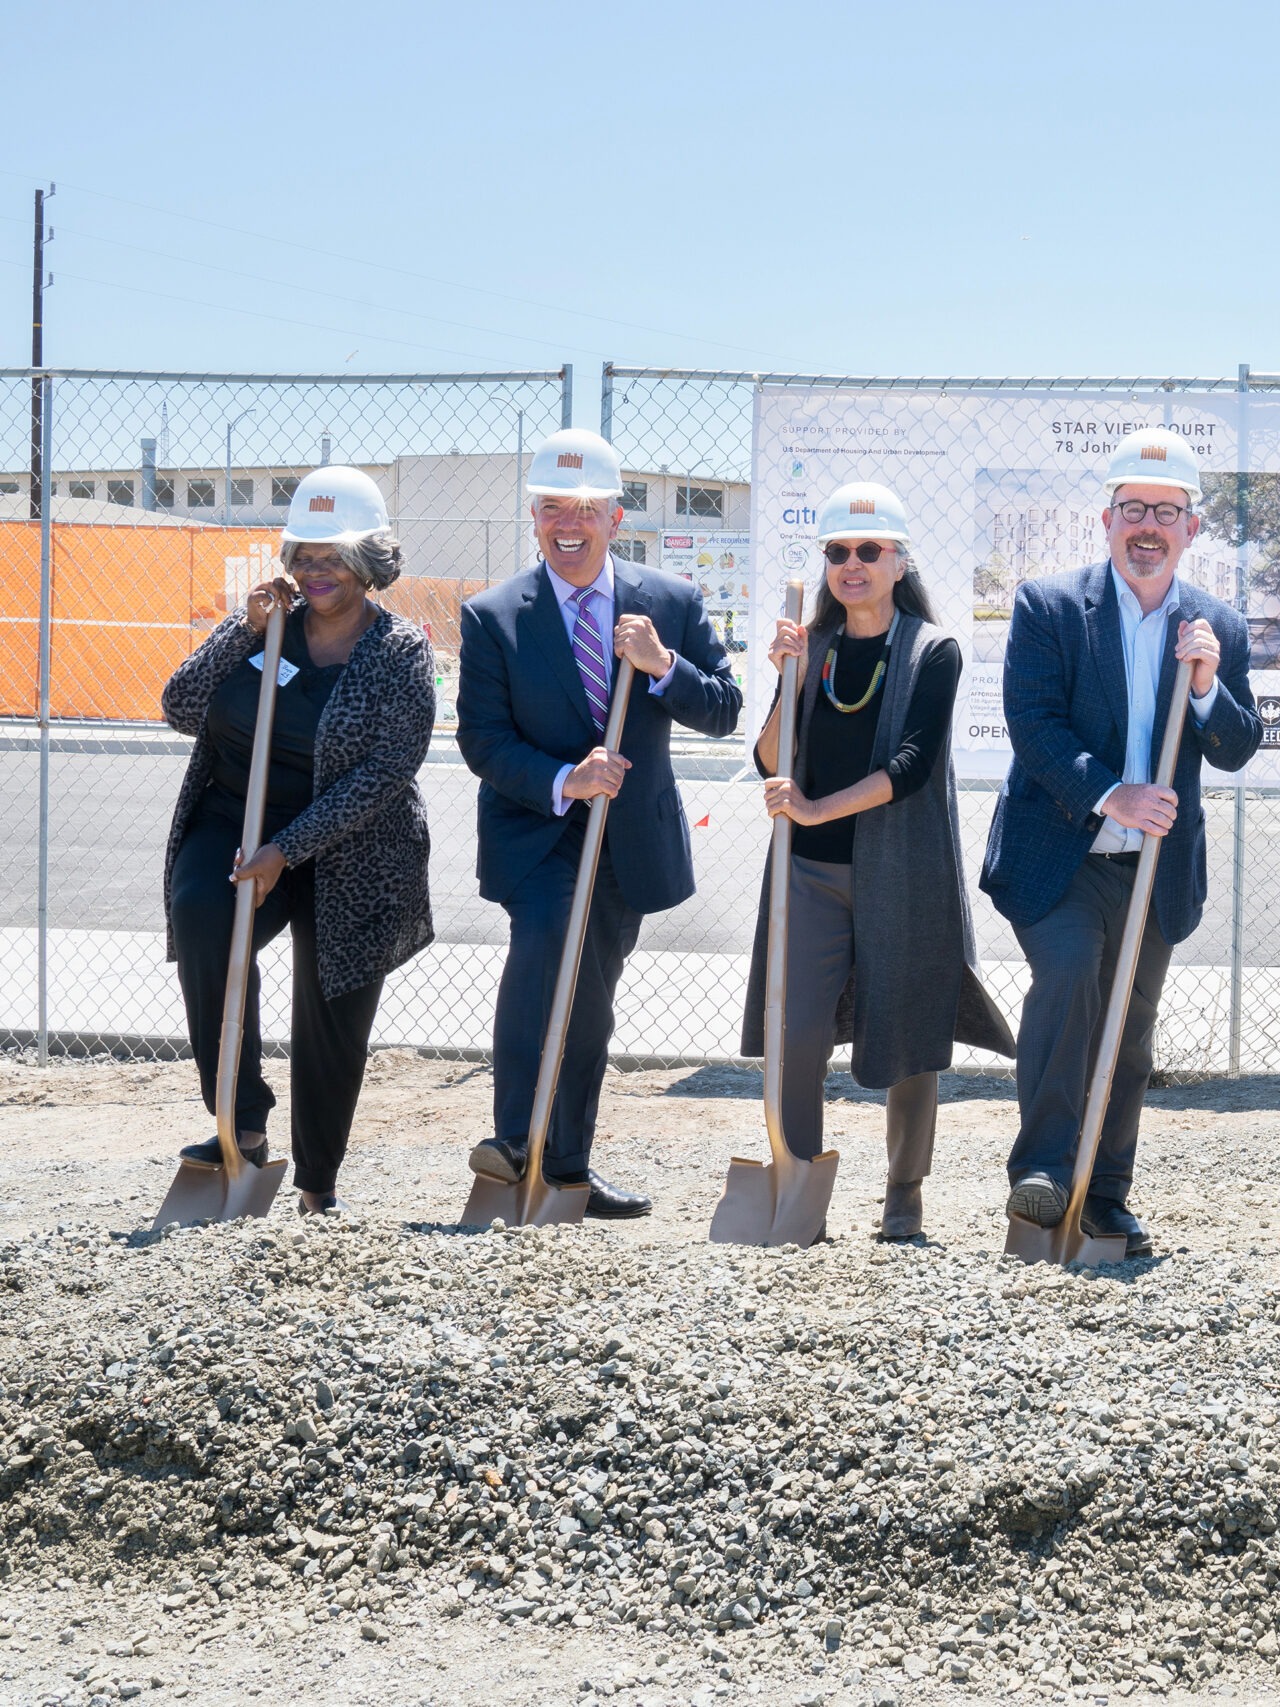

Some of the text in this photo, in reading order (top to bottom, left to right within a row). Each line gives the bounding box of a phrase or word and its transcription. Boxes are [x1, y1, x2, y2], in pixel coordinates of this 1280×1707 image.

[782, 427, 907, 436] SUPPORT PROVIDED BY
[1052, 422, 1097, 435] STAR
[1158, 424, 1216, 436] OURT
[795, 447, 831, 455] Department
[1055, 441, 1074, 453] 78
[1141, 445, 1167, 461] nibbi
[557, 452, 583, 469] nibbi
[309, 496, 335, 512] nibbi
[850, 500, 875, 514] nibbi
[782, 506, 816, 525] citi
[666, 538, 691, 546] DANGER
